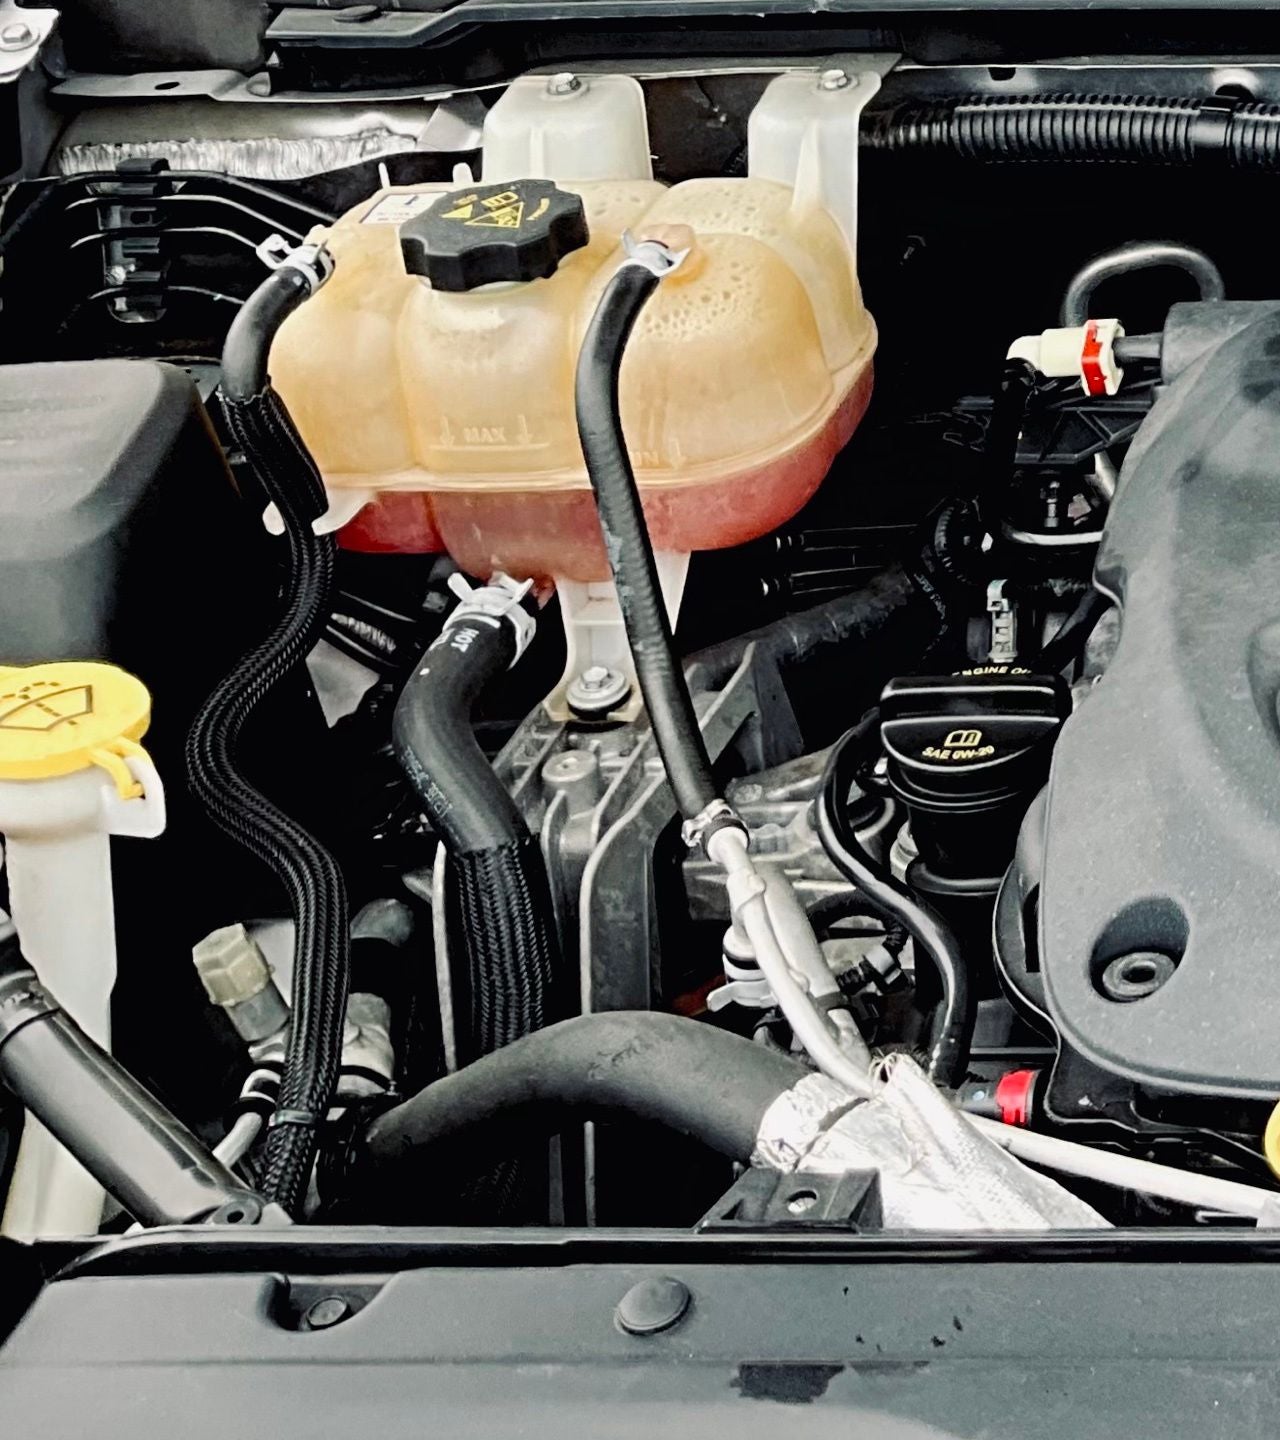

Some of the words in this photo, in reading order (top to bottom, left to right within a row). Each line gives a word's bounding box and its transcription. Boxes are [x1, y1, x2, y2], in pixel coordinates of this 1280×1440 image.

[463, 426, 507, 444] MAX
[450, 626, 480, 653] HOT
[922, 745, 952, 760] SAE
